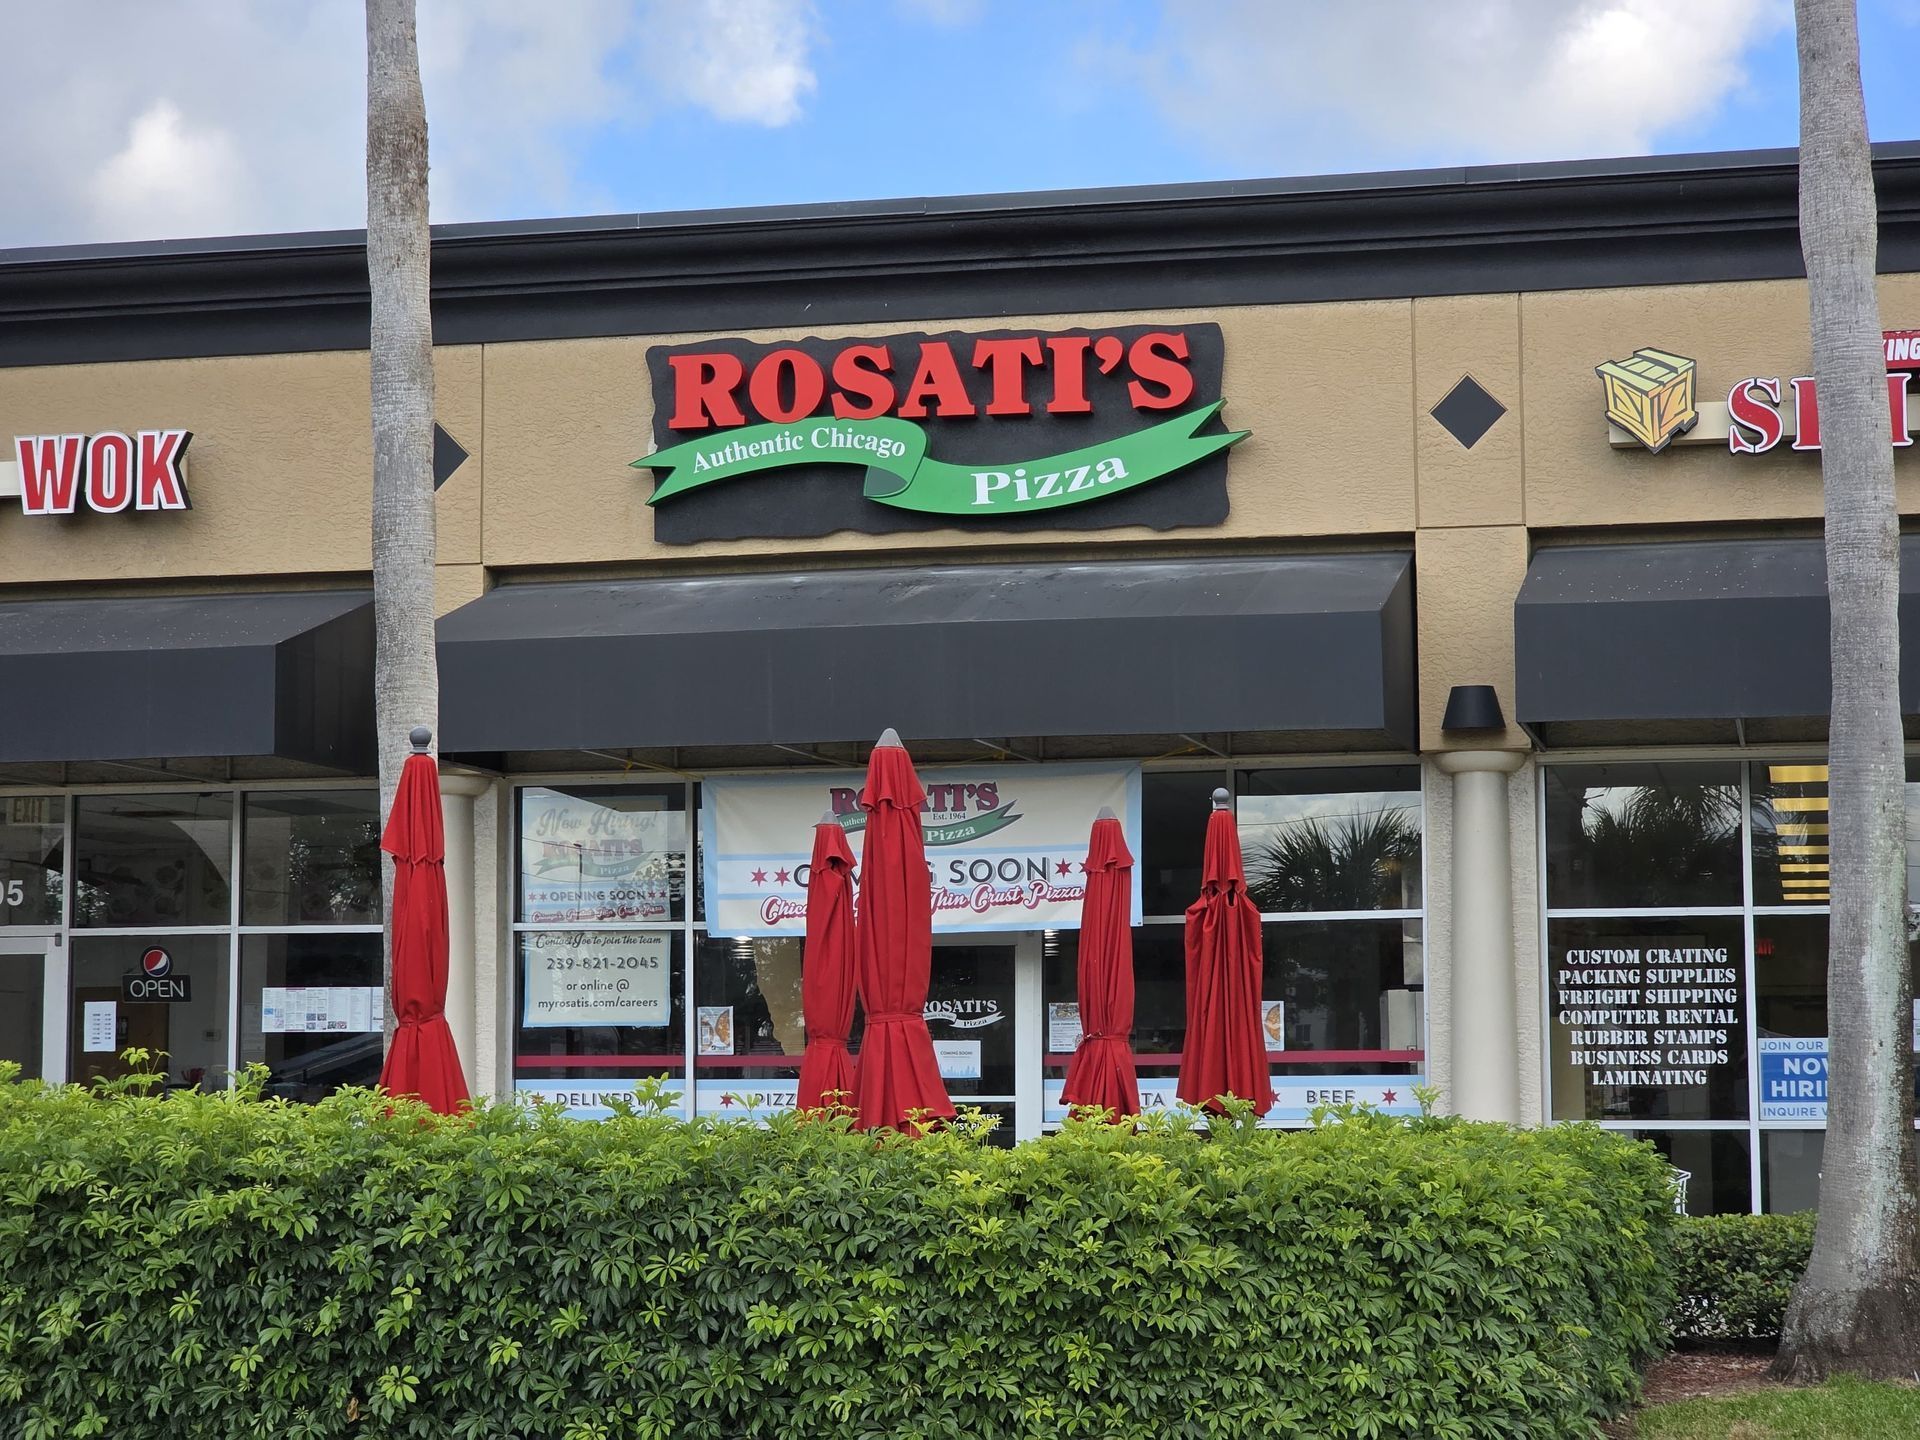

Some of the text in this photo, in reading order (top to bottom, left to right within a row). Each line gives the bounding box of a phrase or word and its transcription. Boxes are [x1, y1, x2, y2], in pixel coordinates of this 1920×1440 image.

[1882, 338, 1920, 362] ING
[668, 332, 1195, 430] ROSATI'S
[693, 427, 906, 474] Authentic Chicago
[15, 429, 194, 515] WOK
[970, 456, 1129, 505] Pizza
[13, 798, 44, 823] EXIT
[933, 812, 966, 821] Est. 1964
[536, 808, 583, 836] Now
[926, 825, 976, 842] Pizza
[950, 857, 1049, 884] SOON
[550, 891, 606, 902] OPENING
[970, 883, 1023, 913] Crust
[1023, 879, 1085, 909] Pizza
[536, 933, 662, 948] Contact Joe to join the team
[547, 957, 659, 970] 239-821-2045
[1566, 948, 1728, 965] CUSTOM CRATING
[580, 979, 613, 991] online
[616, 978, 630, 992] @
[1559, 968, 1736, 985] PACKING SUPPLIES
[130, 980, 184, 998] OPEN
[1559, 988, 1737, 1005] FREIGHT SHIPPING
[538, 996, 658, 1012] myrosatis.com/careers
[963, 1019, 987, 1027] Pizza
[1559, 1009, 1738, 1025] COMPUTER RENTAL
[1571, 1029, 1728, 1045] RUBBER STAMPS
[1761, 1041, 1823, 1050] JOIN OUR
[1571, 1050, 1728, 1065] BUSINESS CARDS
[1784, 1058, 1829, 1075] NO
[1592, 1070, 1707, 1085] LAMINATING
[1306, 1090, 1354, 1103] BEEF
[1771, 1080, 1828, 1097] HIRI
[756, 1093, 796, 1106] PIZZ
[1764, 1107, 1817, 1117] INQUIRE
